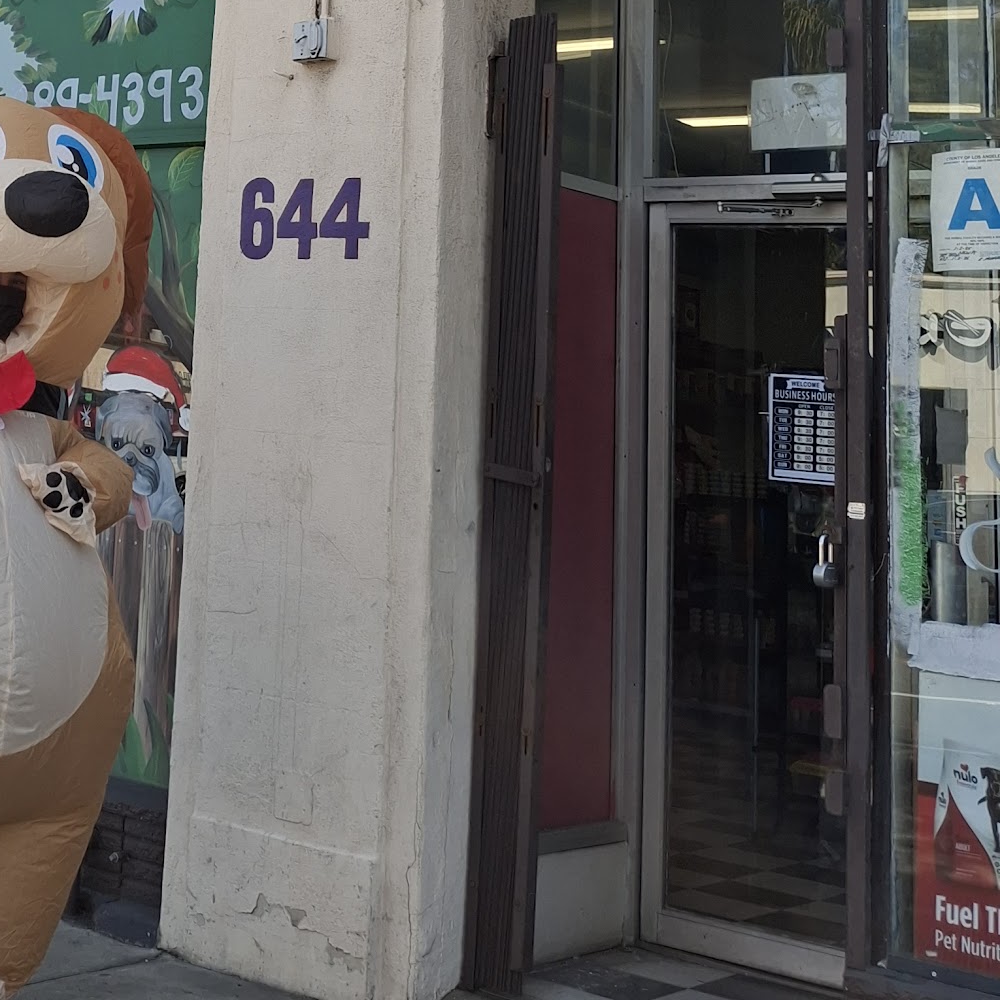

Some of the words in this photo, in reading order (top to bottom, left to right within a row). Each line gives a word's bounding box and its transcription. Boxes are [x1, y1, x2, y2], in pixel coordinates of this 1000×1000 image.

[239, 177, 370, 260] 644
[948, 178, 1000, 231] A
[774, 389, 810, 400] BUSINESS
[953, 769, 979, 785] nulo
[935, 894, 979, 930] Fuel
[985, 904, 1000, 936] T
[935, 929, 957, 952] Pet
